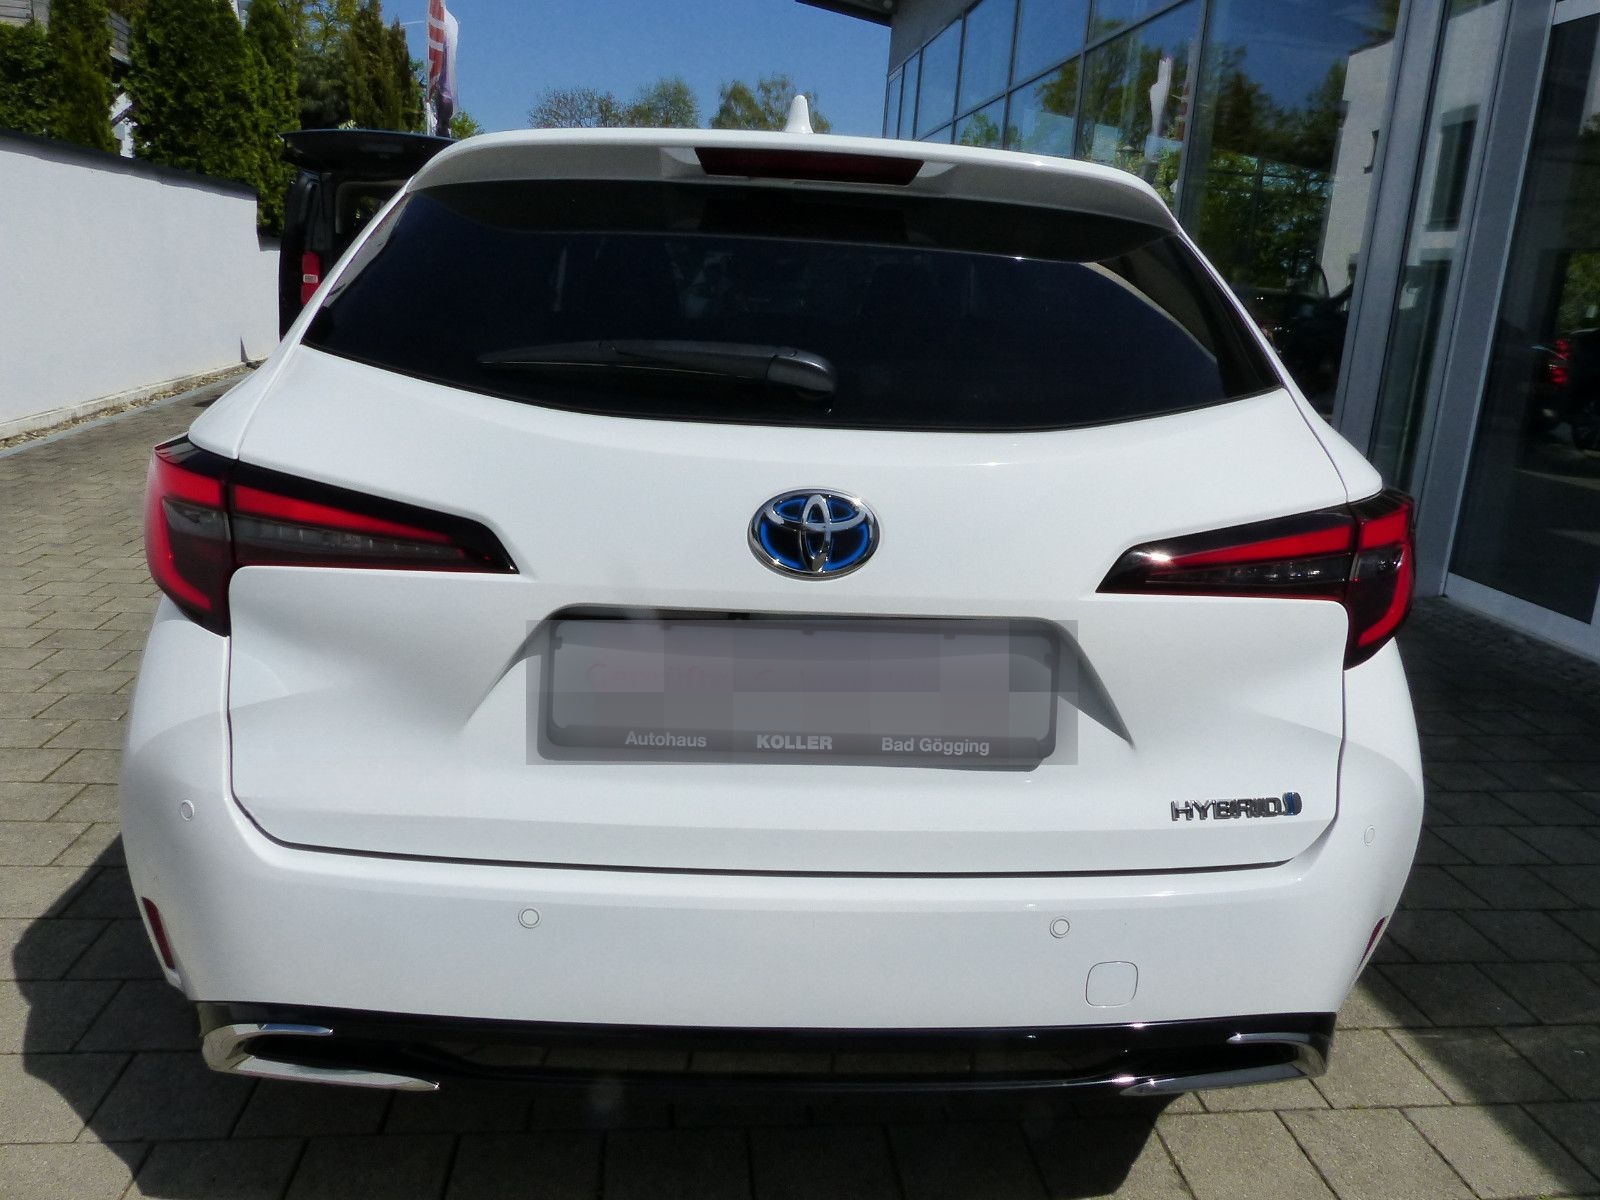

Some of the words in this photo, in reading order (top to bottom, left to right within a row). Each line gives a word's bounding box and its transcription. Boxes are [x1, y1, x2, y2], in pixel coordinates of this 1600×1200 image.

[625, 730, 707, 748] Autohaus
[756, 734, 833, 750] KOLLER
[881, 737, 914, 752] Bad
[919, 738, 990, 756] Gögging
[1170, 797, 1282, 822] HYBRID
